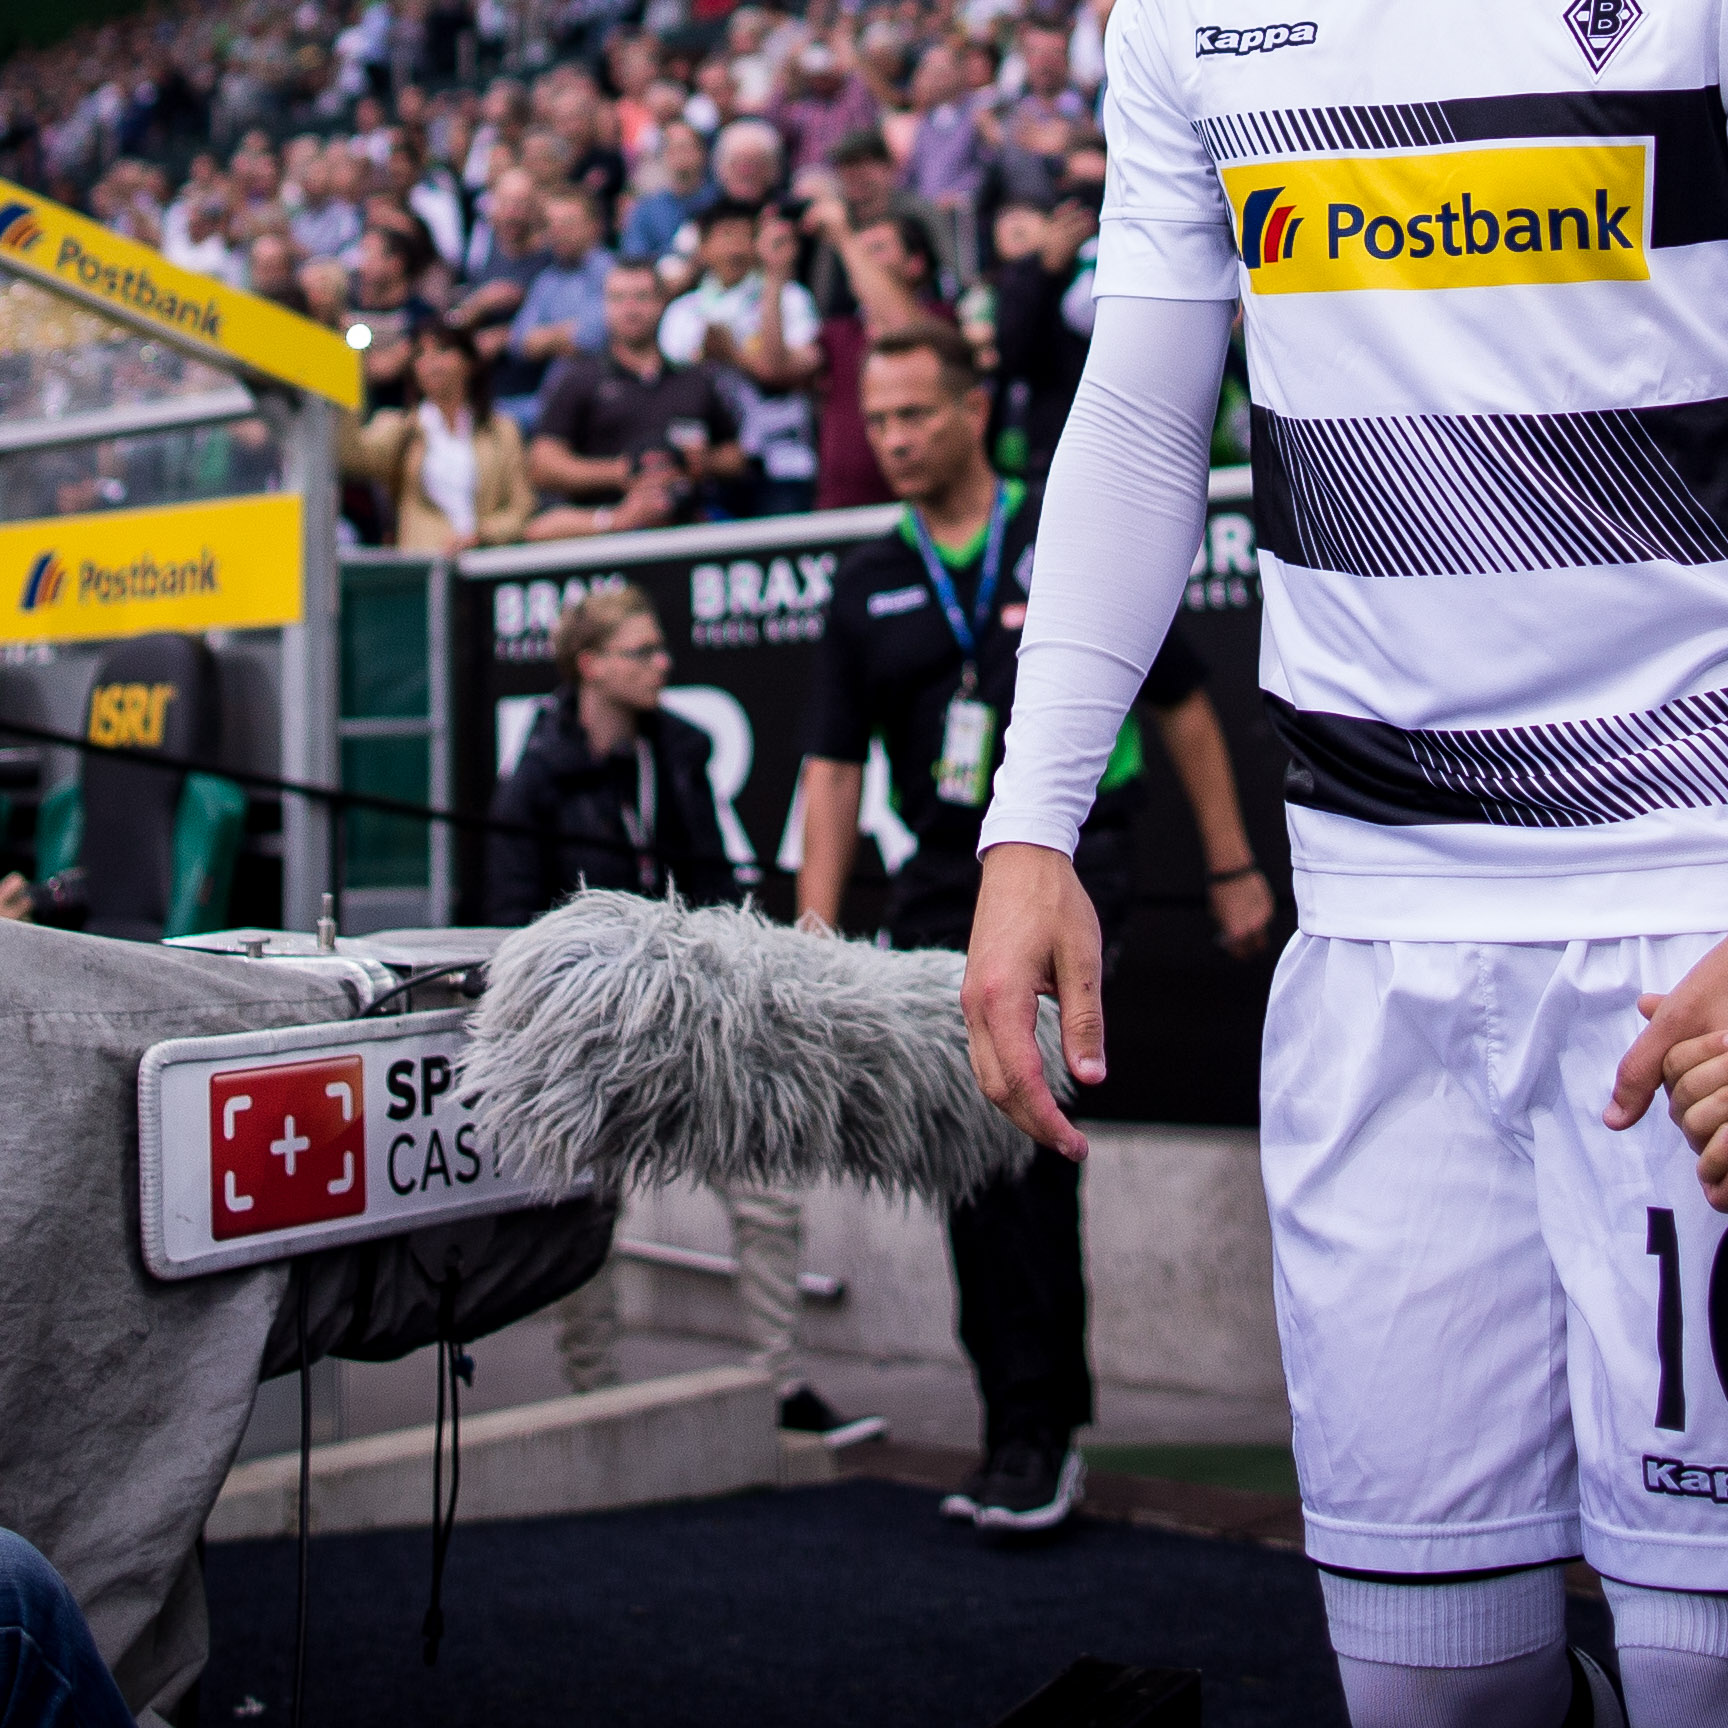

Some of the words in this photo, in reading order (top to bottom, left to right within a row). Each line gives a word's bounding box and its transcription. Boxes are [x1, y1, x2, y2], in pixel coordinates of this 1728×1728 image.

[1195, 20, 1318, 59] Kappa
[1328, 189, 1634, 260] Postbank
[55, 236, 227, 339] Postbank
[78, 550, 219, 602] Postbank
[88, 683, 175, 747] ISRI
